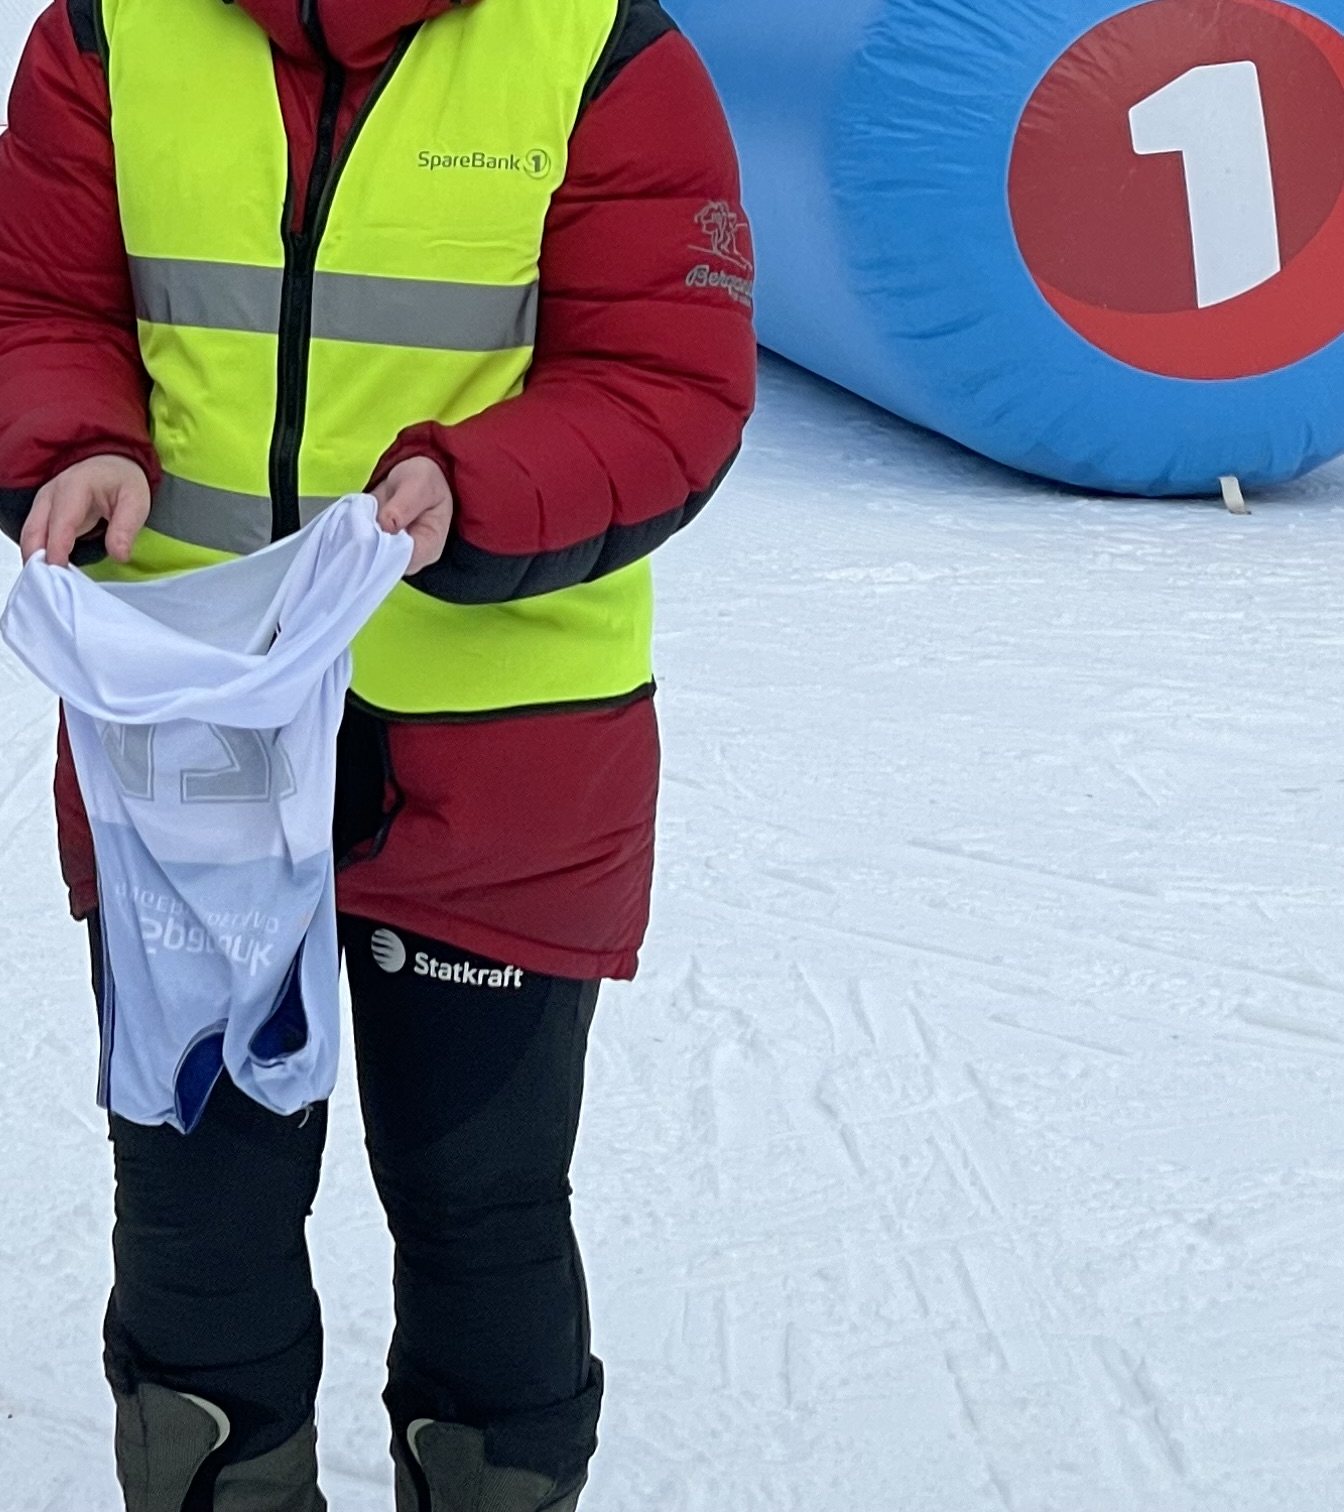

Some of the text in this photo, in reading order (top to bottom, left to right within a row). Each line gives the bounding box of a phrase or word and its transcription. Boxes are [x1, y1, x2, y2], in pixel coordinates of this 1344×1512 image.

[417, 151, 520, 171] SpareBank
[1128, 60, 1281, 308] 1
[413, 951, 525, 988] Statkraft
